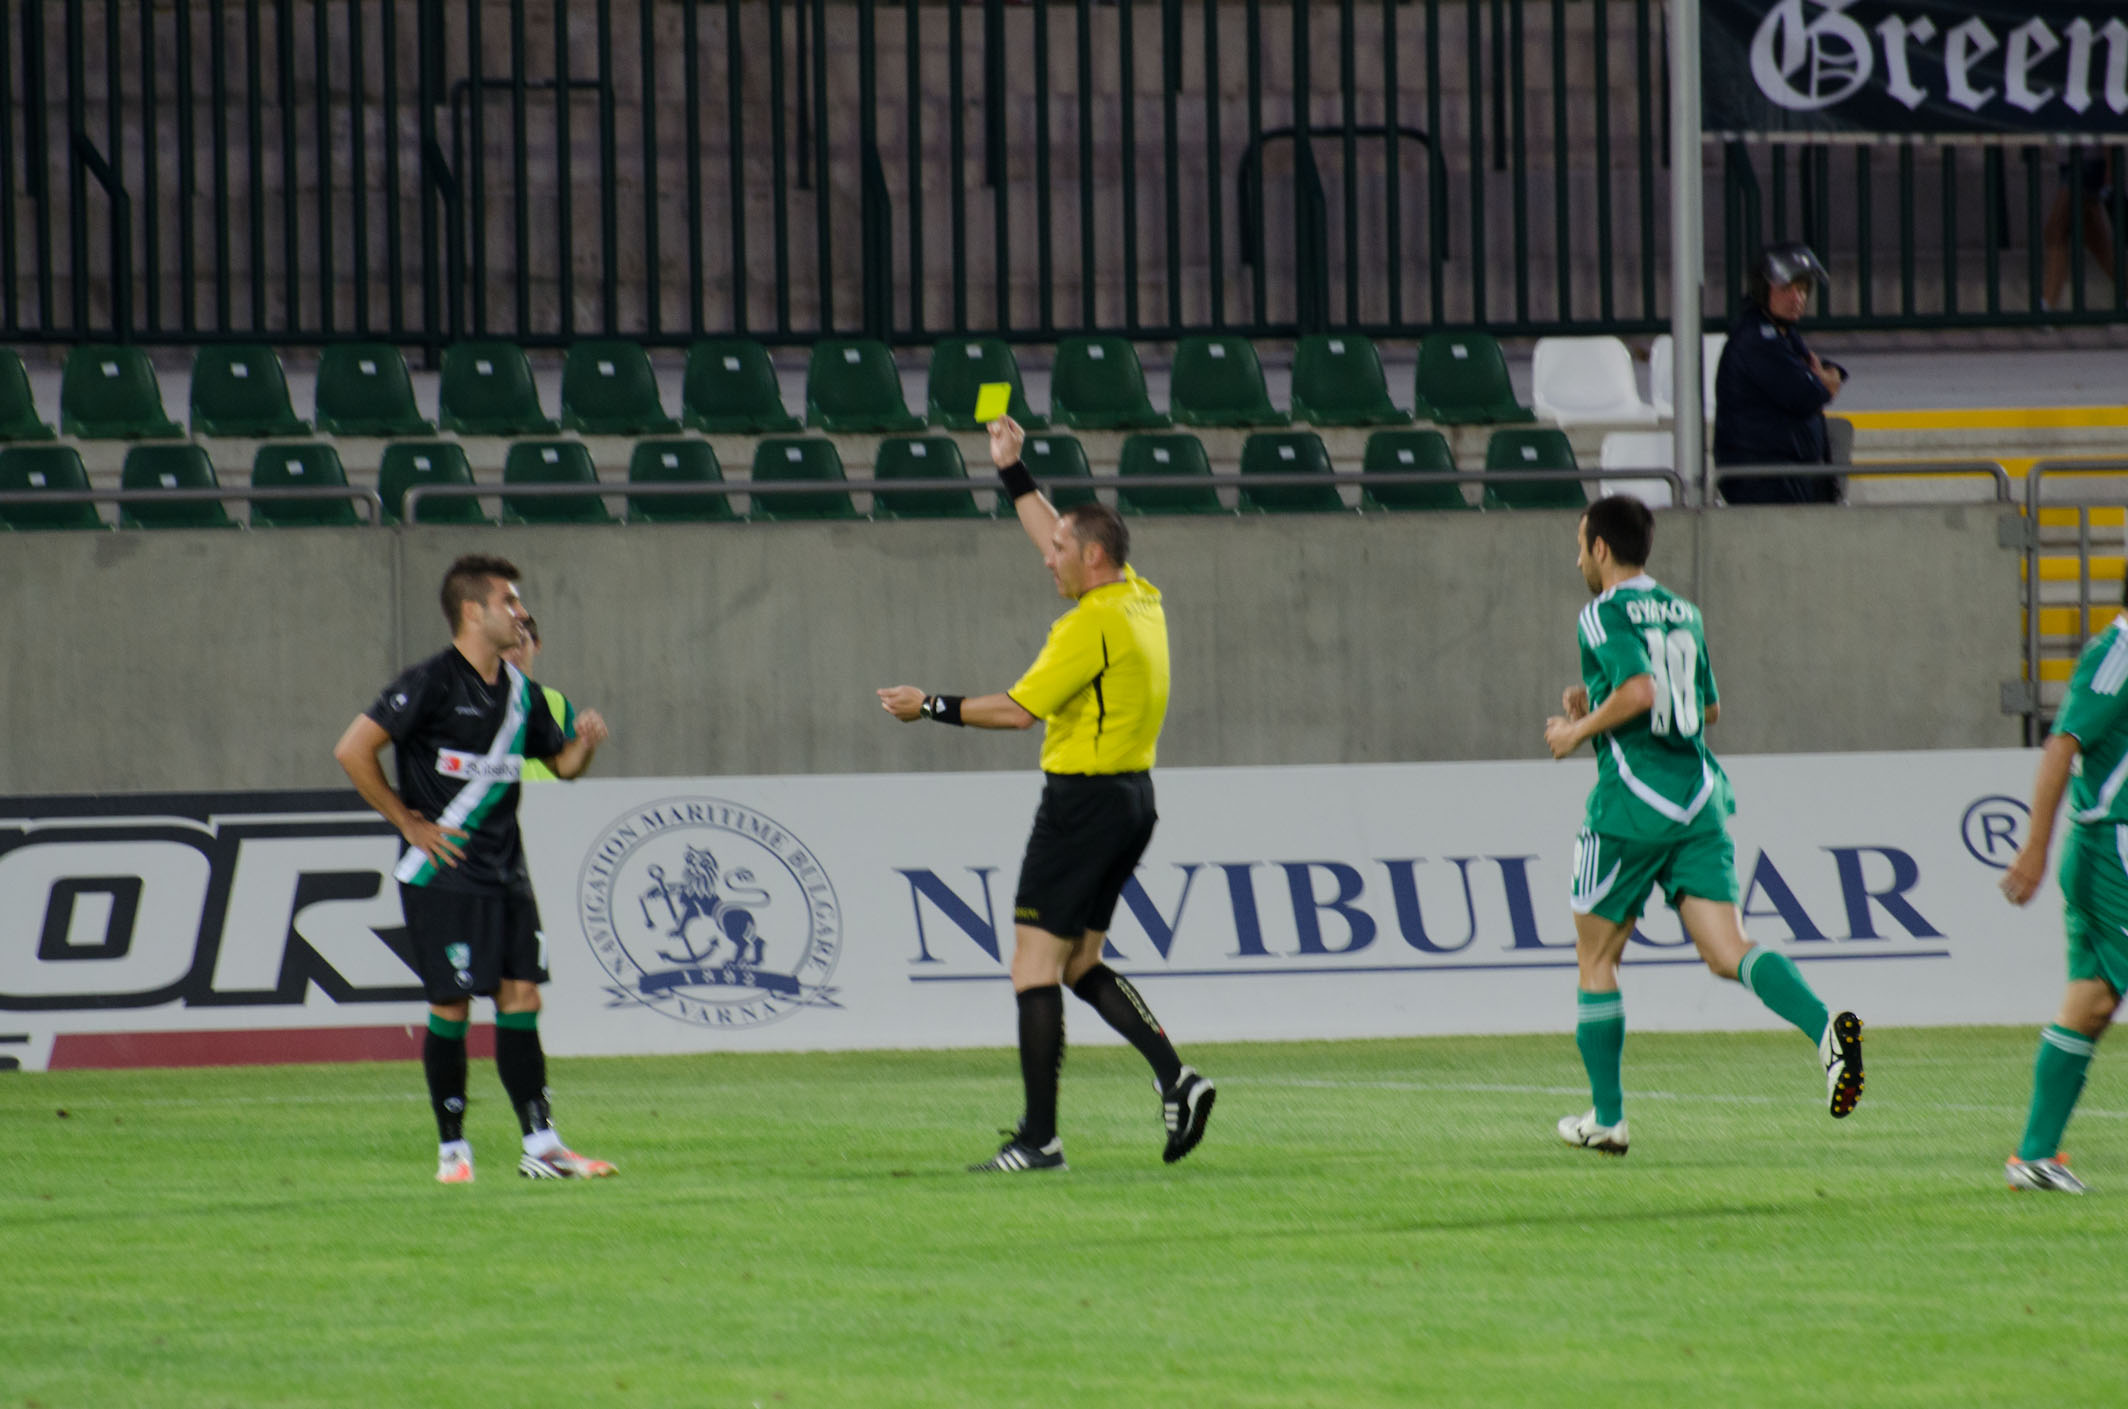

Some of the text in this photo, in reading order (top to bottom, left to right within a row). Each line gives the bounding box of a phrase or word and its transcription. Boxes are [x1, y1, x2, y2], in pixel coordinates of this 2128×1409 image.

[1750, 0, 2128, 114] Green
[640, 803, 789, 850] MARITIME
[892, 846, 1950, 964] NVIBULAR
[677, 999, 778, 1024] VARNA
